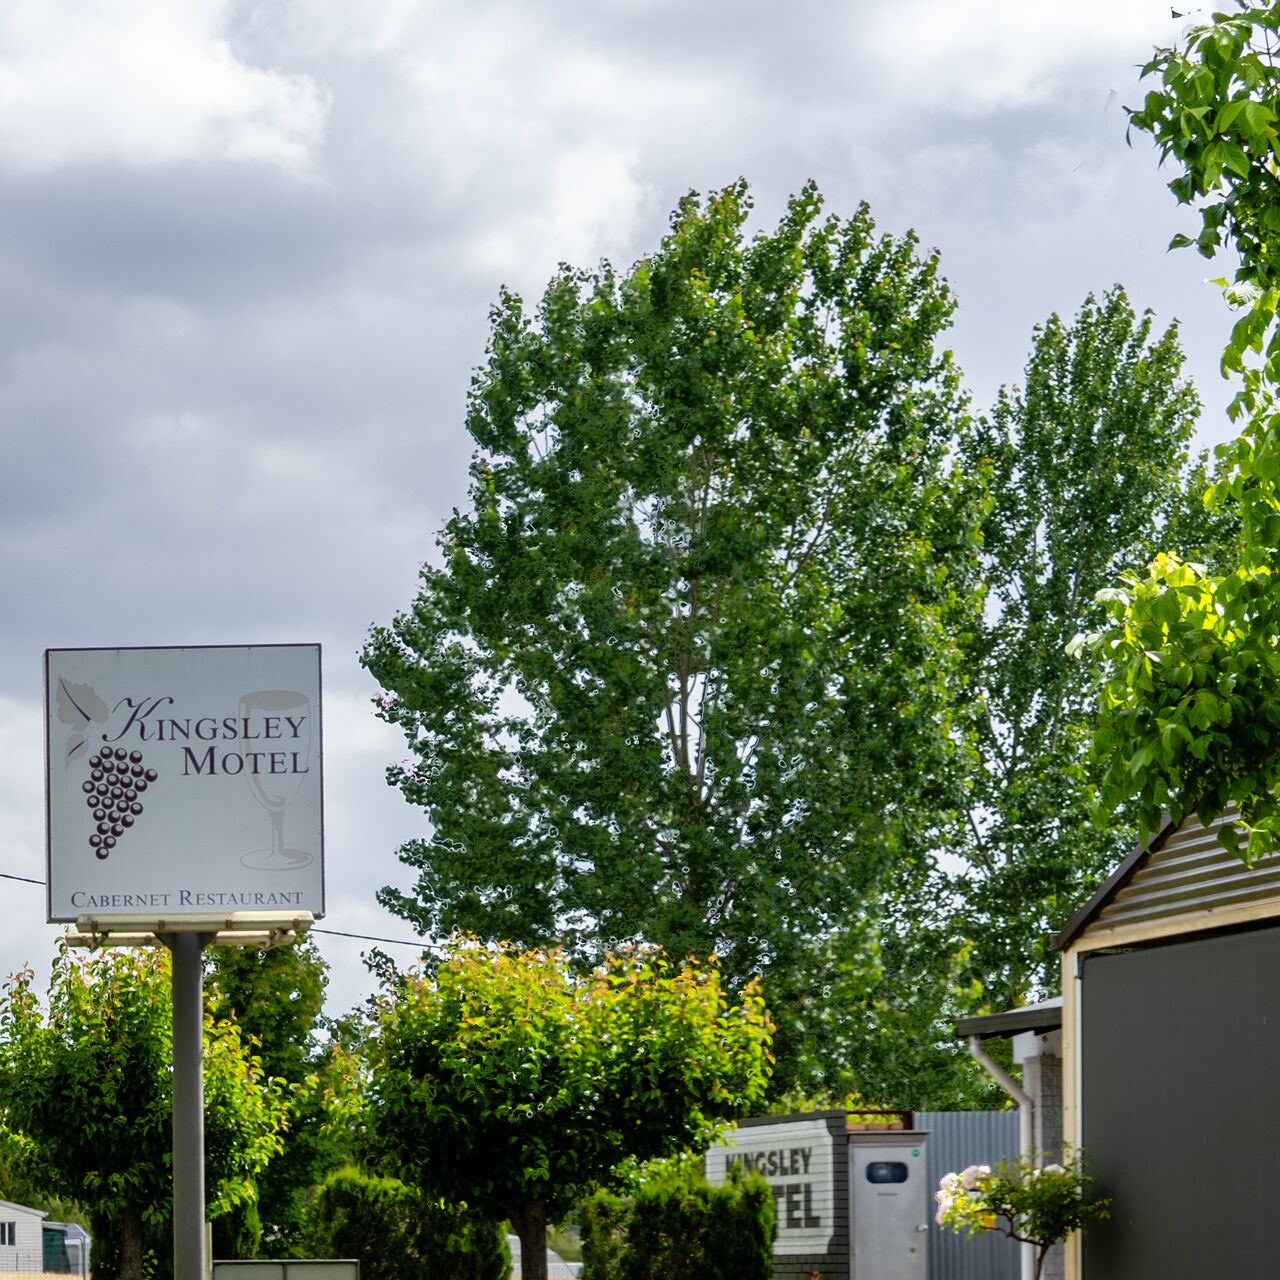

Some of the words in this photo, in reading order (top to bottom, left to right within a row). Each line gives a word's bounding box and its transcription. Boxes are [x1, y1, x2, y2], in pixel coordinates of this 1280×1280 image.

[101, 696, 307, 742] KINGSLEY
[180, 745, 311, 776] MOTEL
[70, 891, 171, 909] CABERNET
[179, 889, 304, 907] RESTAURANT
